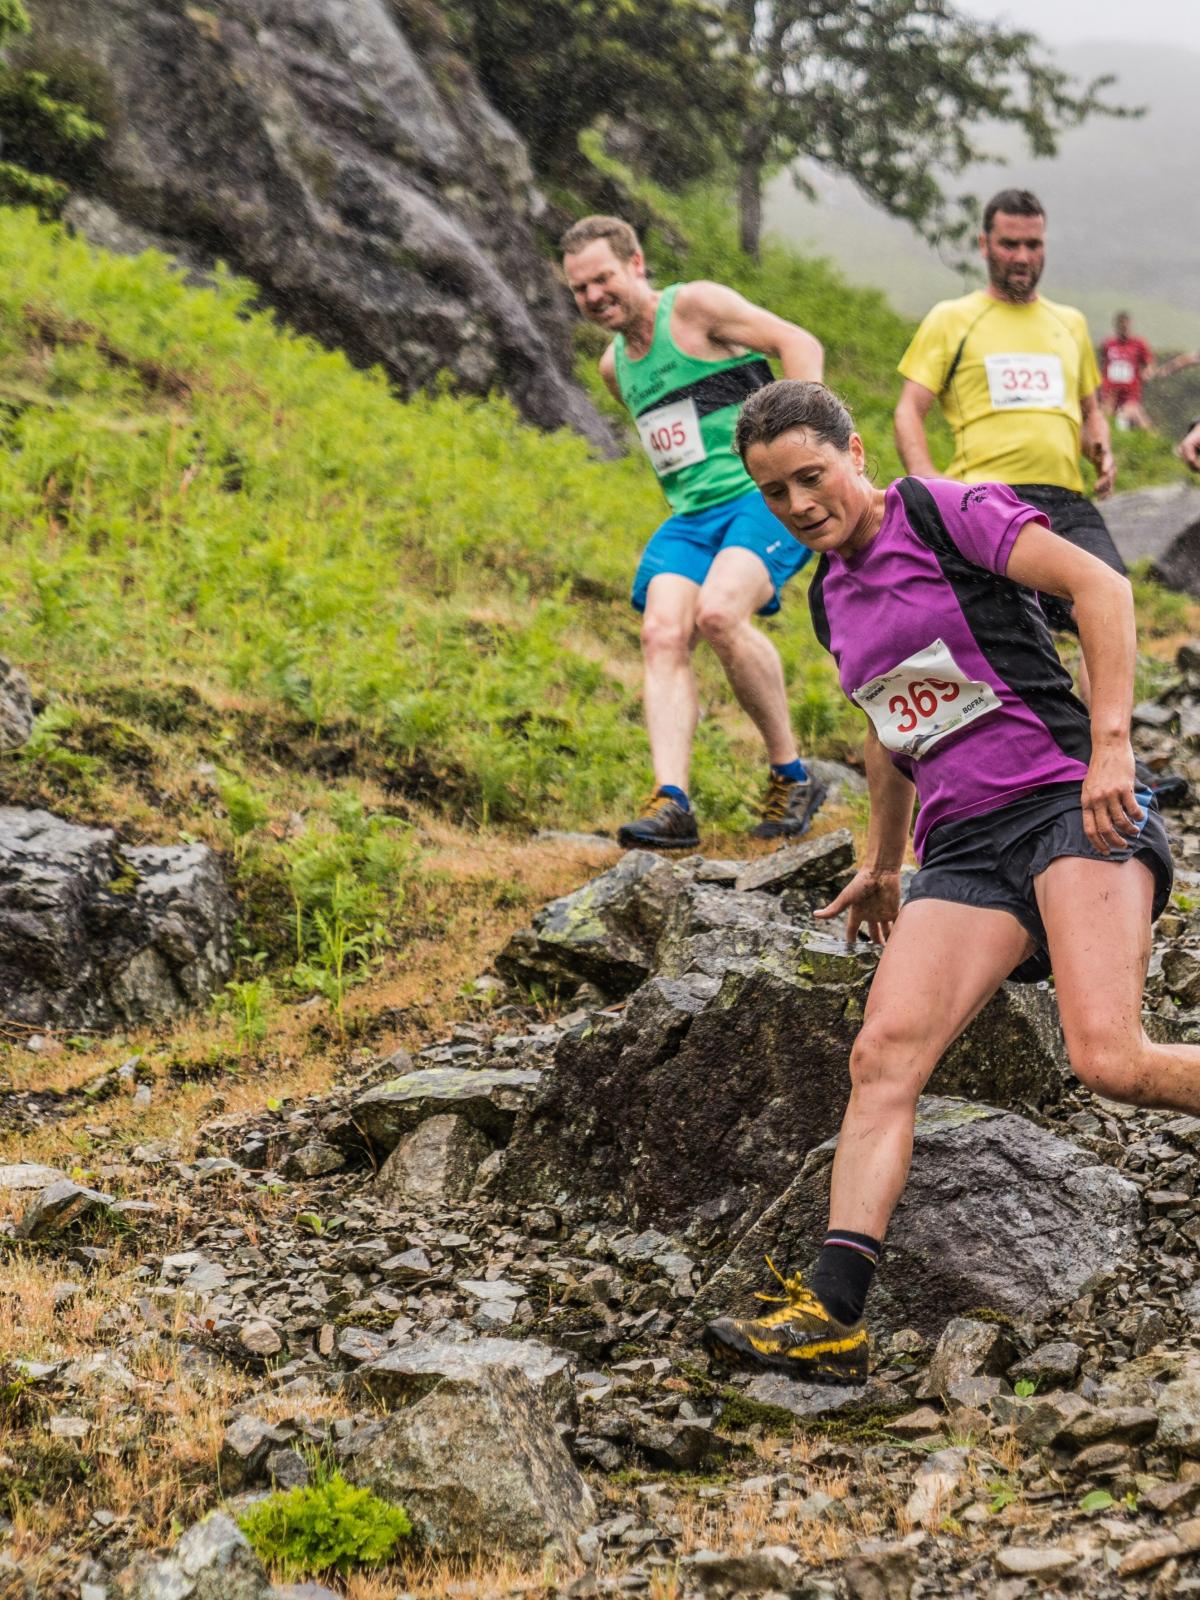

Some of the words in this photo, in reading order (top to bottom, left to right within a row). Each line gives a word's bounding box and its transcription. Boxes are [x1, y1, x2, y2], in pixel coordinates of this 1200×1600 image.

[1002, 369, 1050, 391] 323
[651, 421, 686, 453] 405
[962, 695, 984, 715] BOFRA
